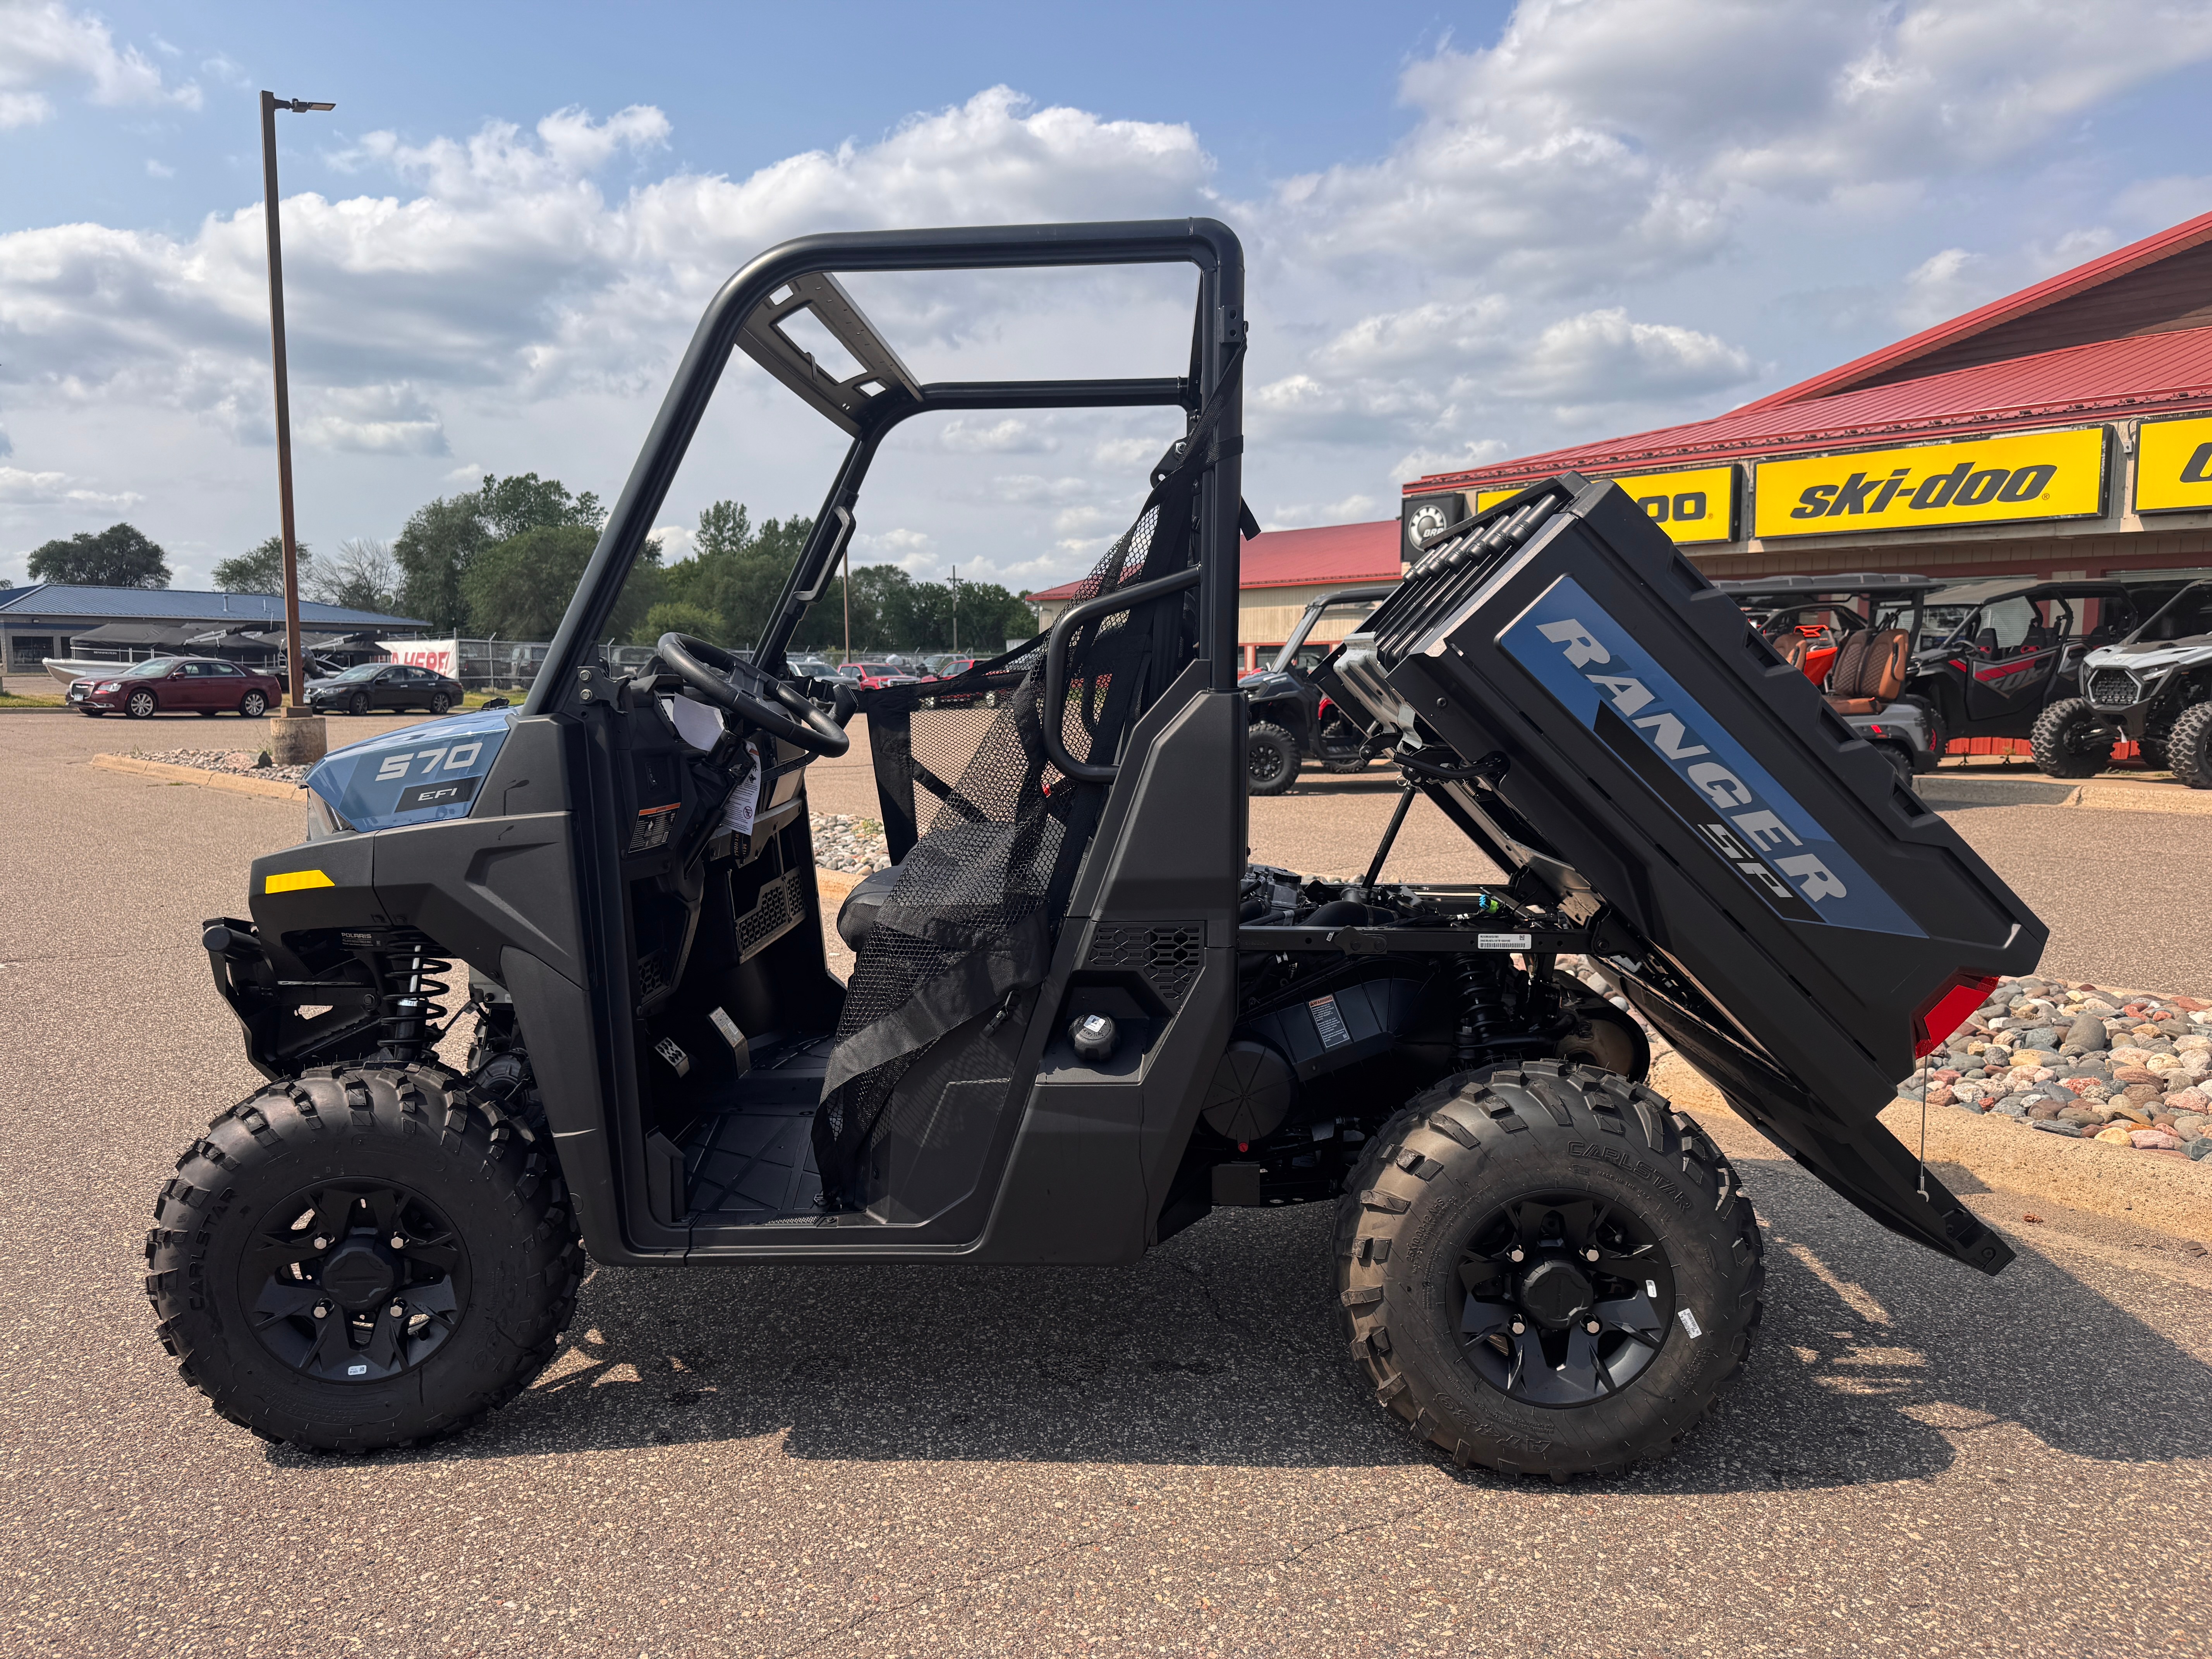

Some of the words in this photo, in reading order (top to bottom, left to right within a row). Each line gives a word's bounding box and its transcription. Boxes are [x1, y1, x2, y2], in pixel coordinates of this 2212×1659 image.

[1790, 462, 2057, 519] ski-doo
[375, 742, 483, 781] 570
[418, 788, 457, 801] EFI
[1536, 618, 1846, 902] RANGER
[1697, 824, 1793, 898] SP
[1568, 1141, 1692, 1212] CARLSTAR
[189, 1187, 239, 1310] CARLSTAR
